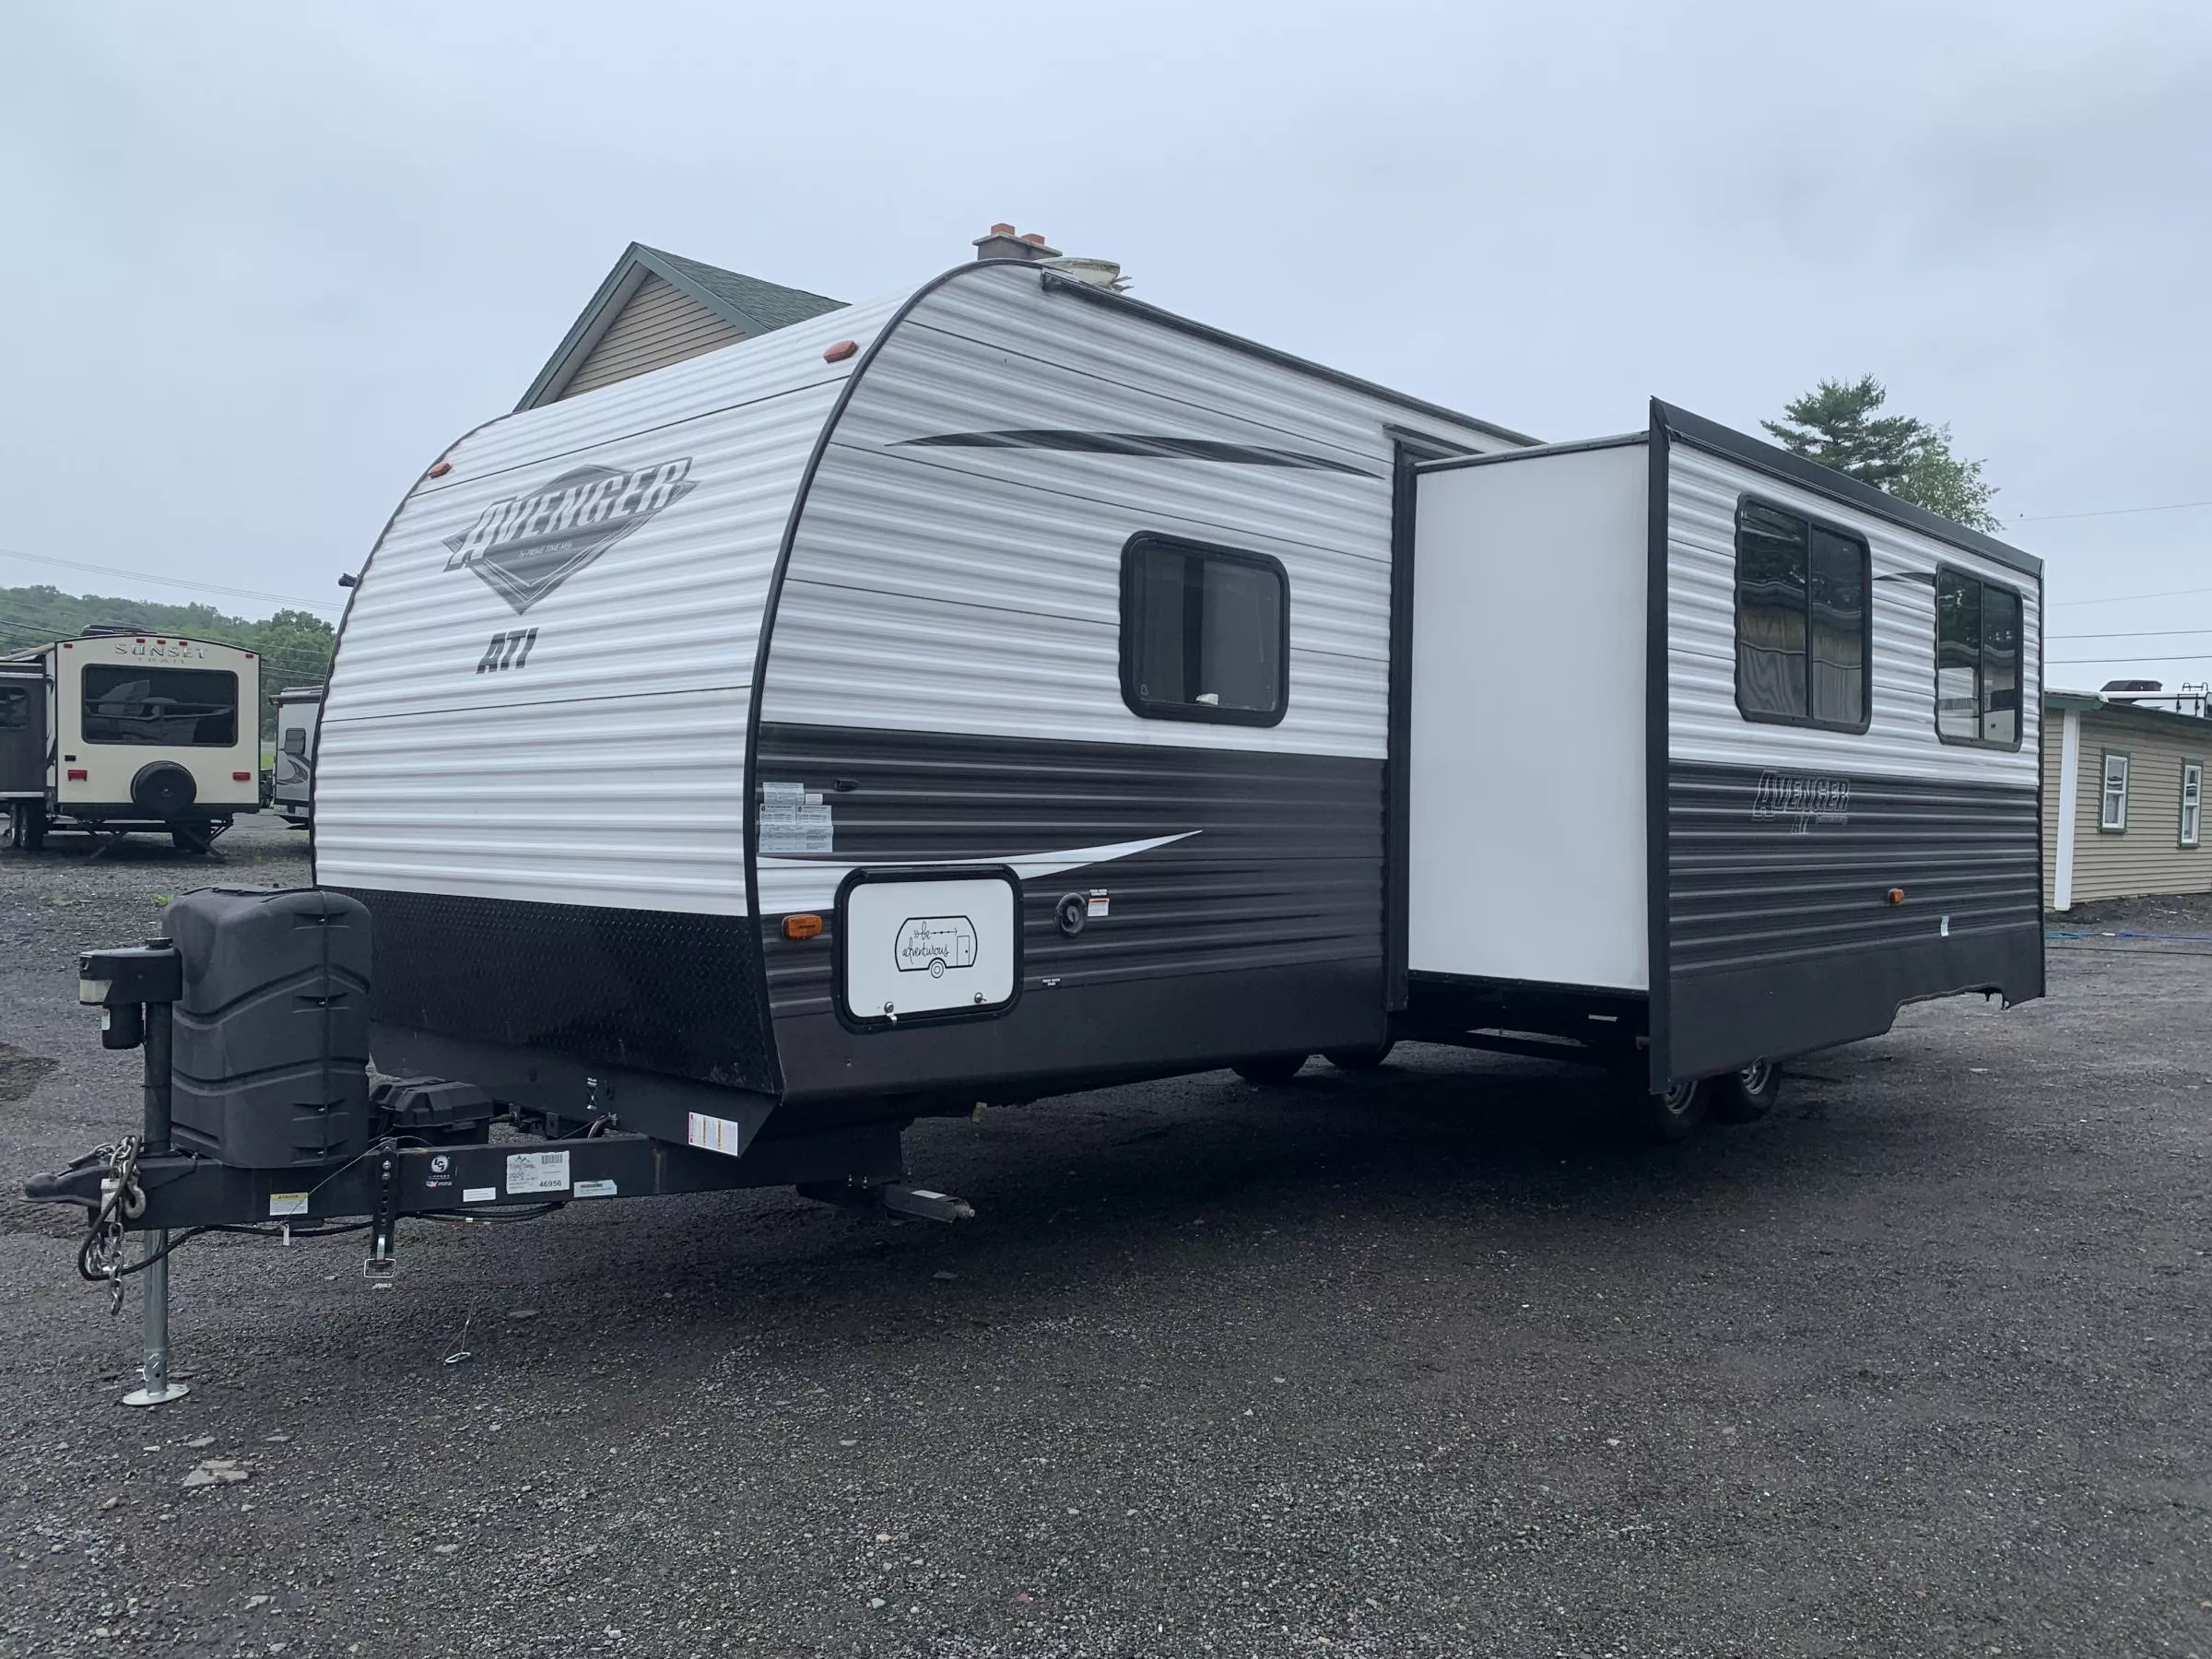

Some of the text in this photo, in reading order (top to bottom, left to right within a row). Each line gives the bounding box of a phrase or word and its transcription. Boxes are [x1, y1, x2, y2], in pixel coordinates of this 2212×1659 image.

[444, 457, 692, 572] AVENGER
[115, 644, 207, 659] SUNSET
[477, 628, 539, 674] ATI
[1752, 770, 1849, 821] AVENGER
[902, 936, 949, 965] adventurous
[539, 1180, 562, 1188] 46956
